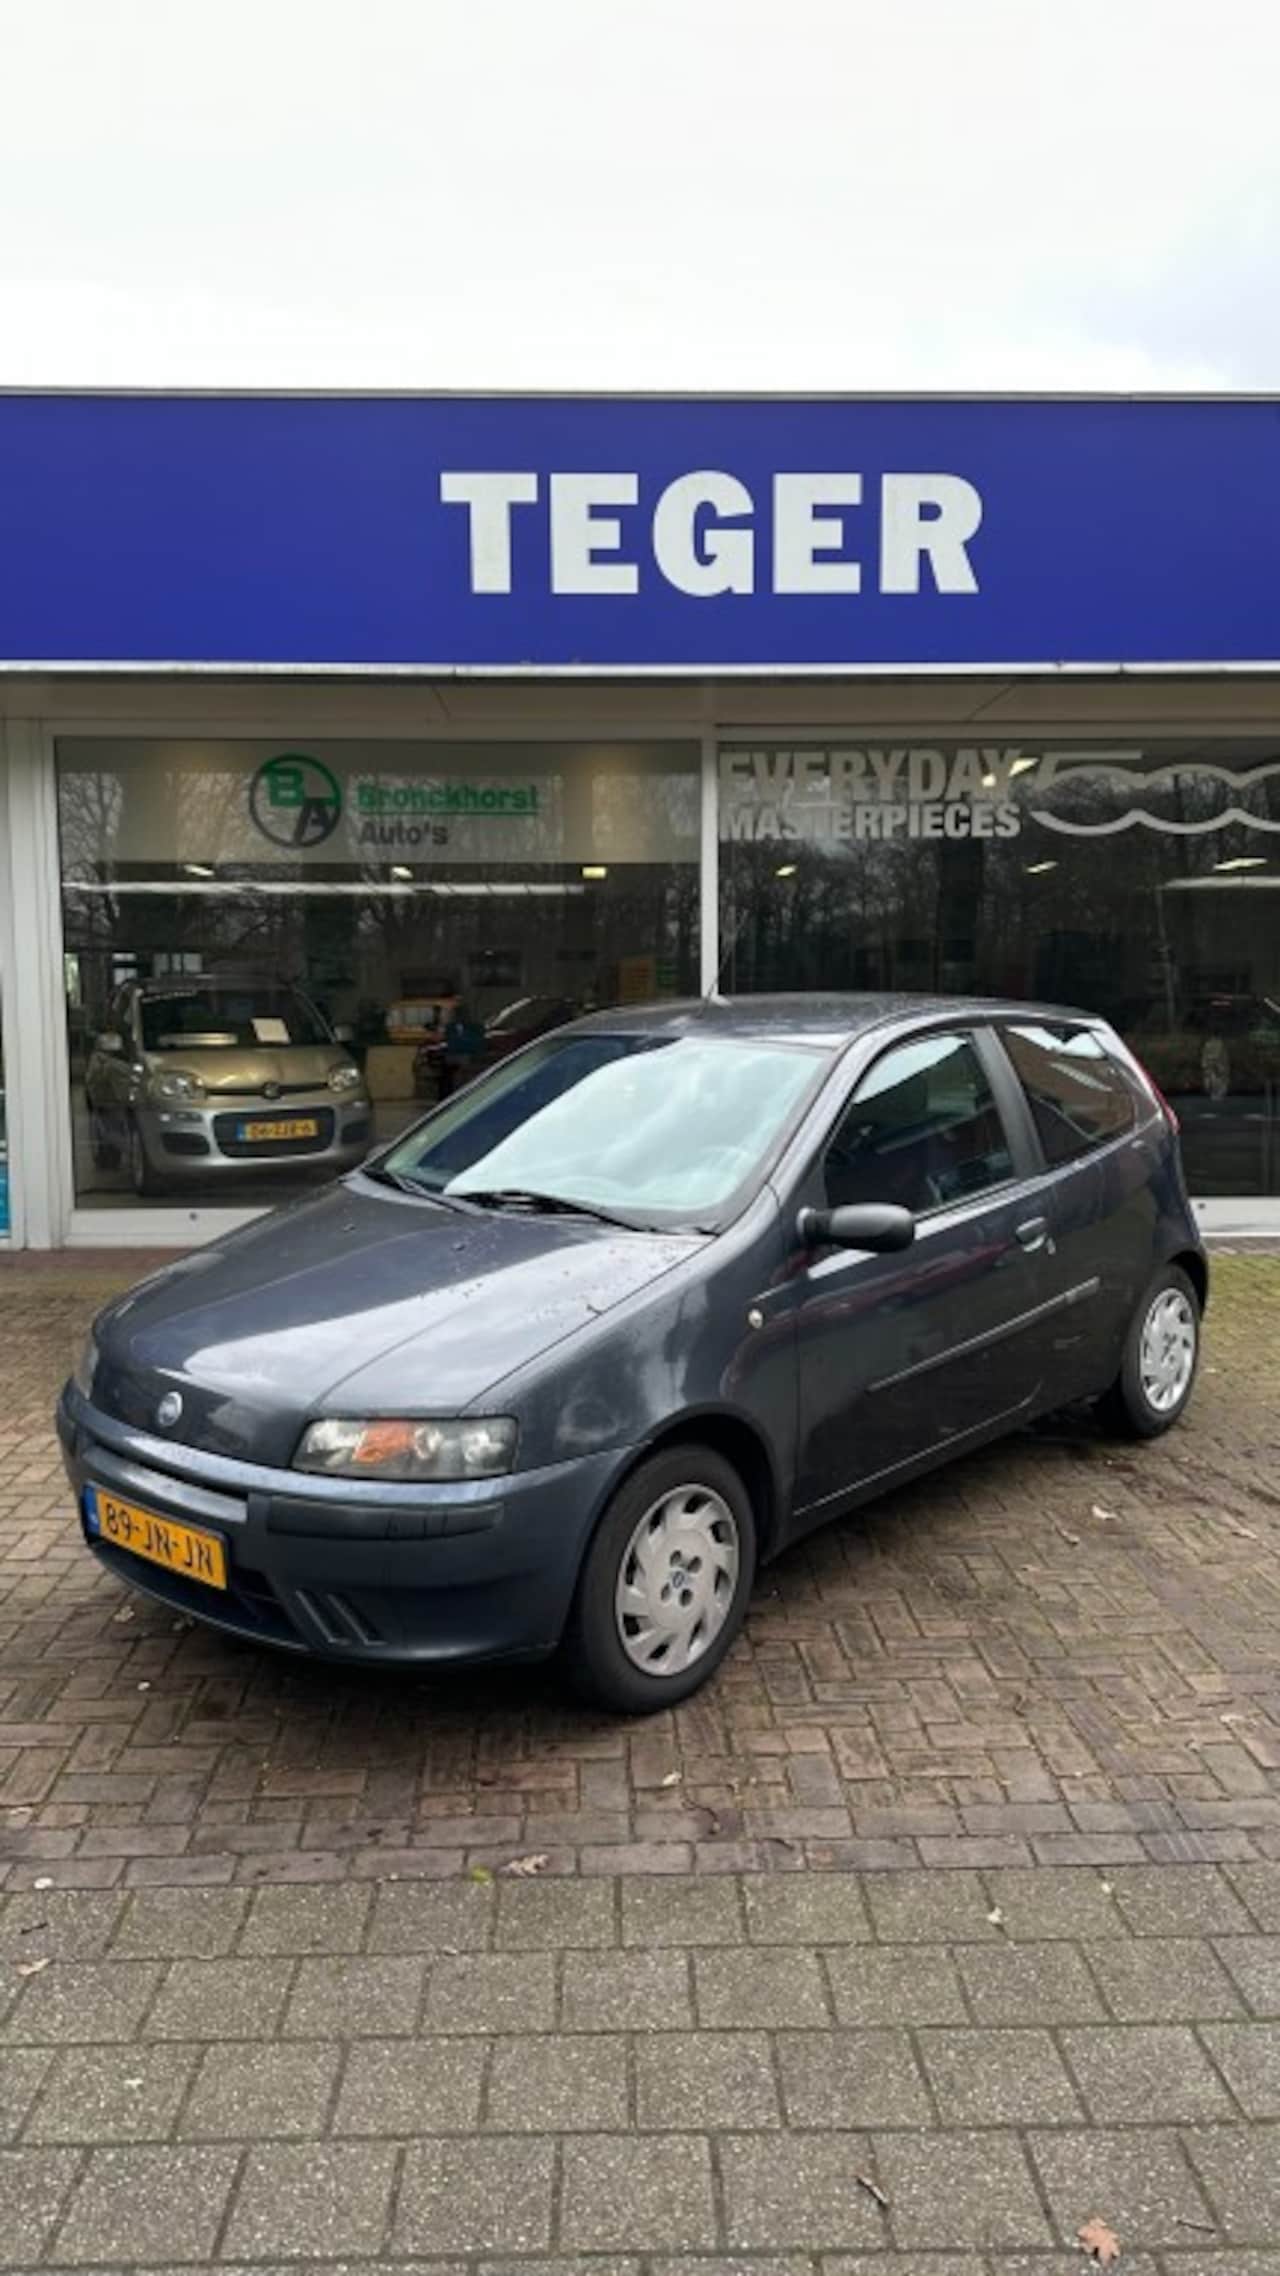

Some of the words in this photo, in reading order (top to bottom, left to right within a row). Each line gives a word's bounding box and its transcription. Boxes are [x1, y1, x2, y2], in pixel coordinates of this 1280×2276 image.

[440, 470, 983, 597] TEGER
[357, 784, 539, 810] Bronckhorst
[719, 748, 1024, 801] EVERYDAY
[357, 821, 449, 846] Auto's
[719, 804, 1022, 841] MASTERPIECES
[106, 1503, 215, 1578] 89-JN-JN
